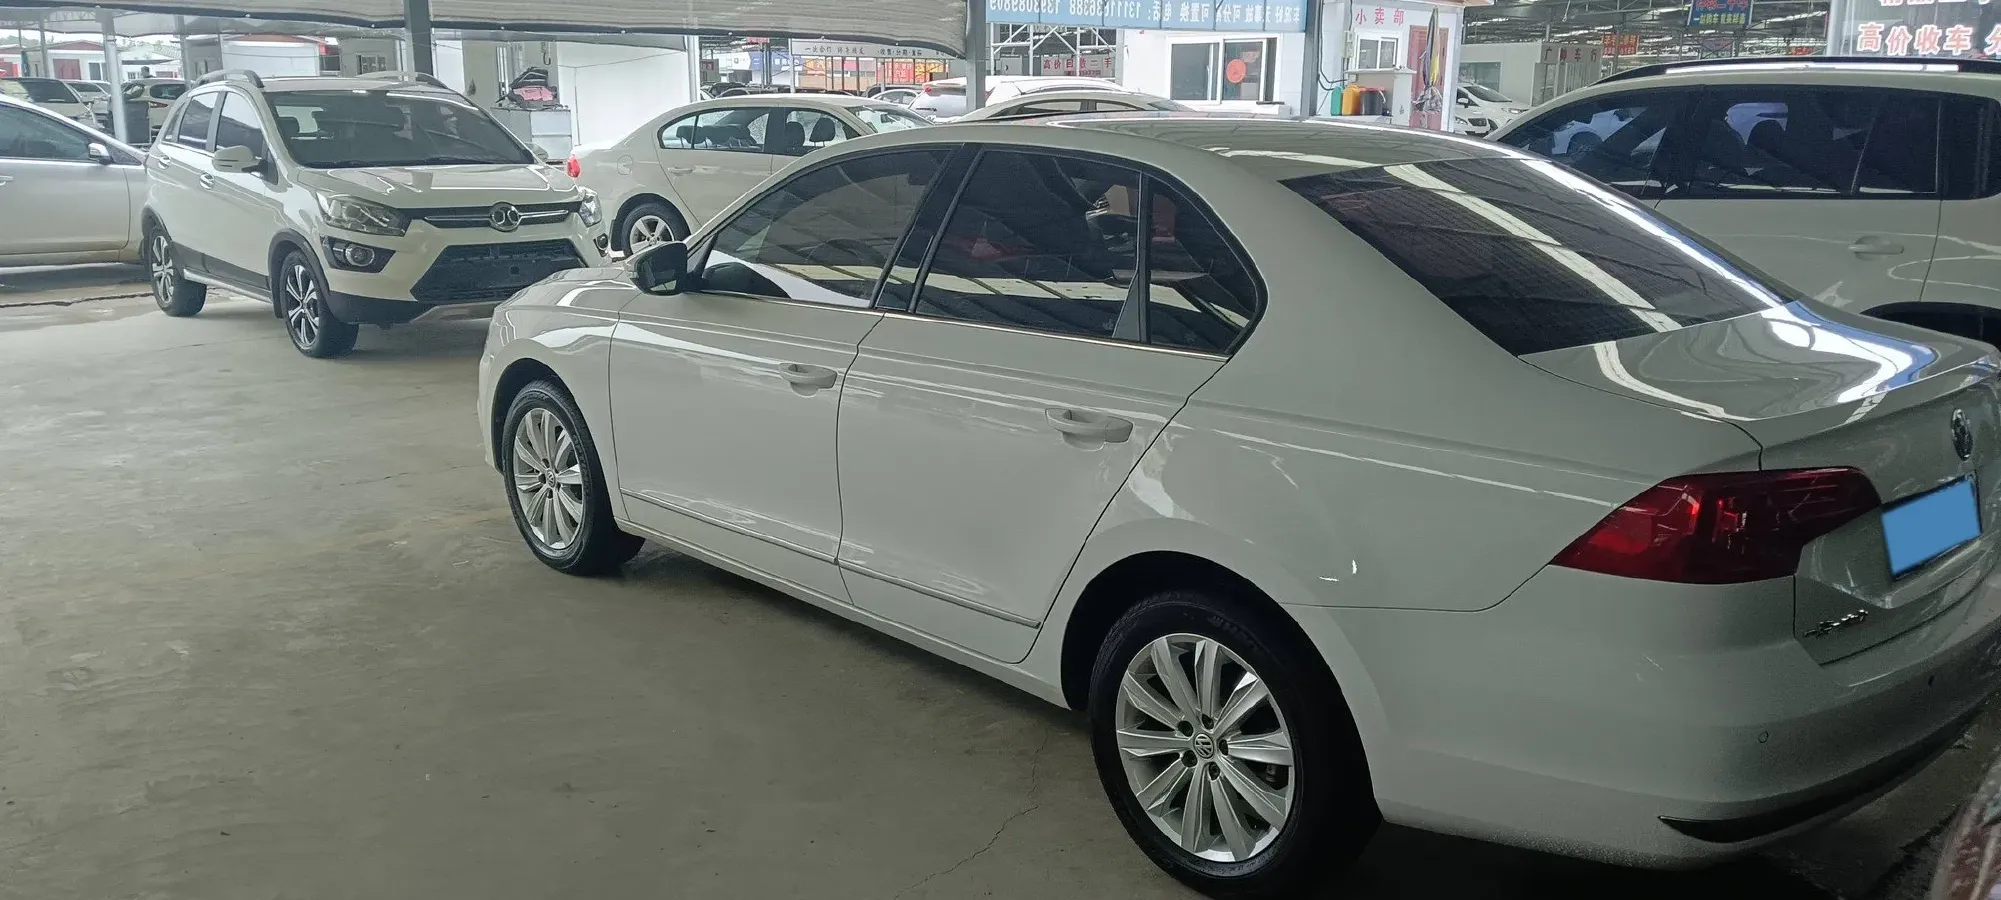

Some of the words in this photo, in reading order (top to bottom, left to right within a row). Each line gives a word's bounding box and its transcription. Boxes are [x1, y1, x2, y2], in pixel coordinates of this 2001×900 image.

[1355, 7, 1405, 26] 小卖部
[1857, 22, 1973, 56] 高价收车
